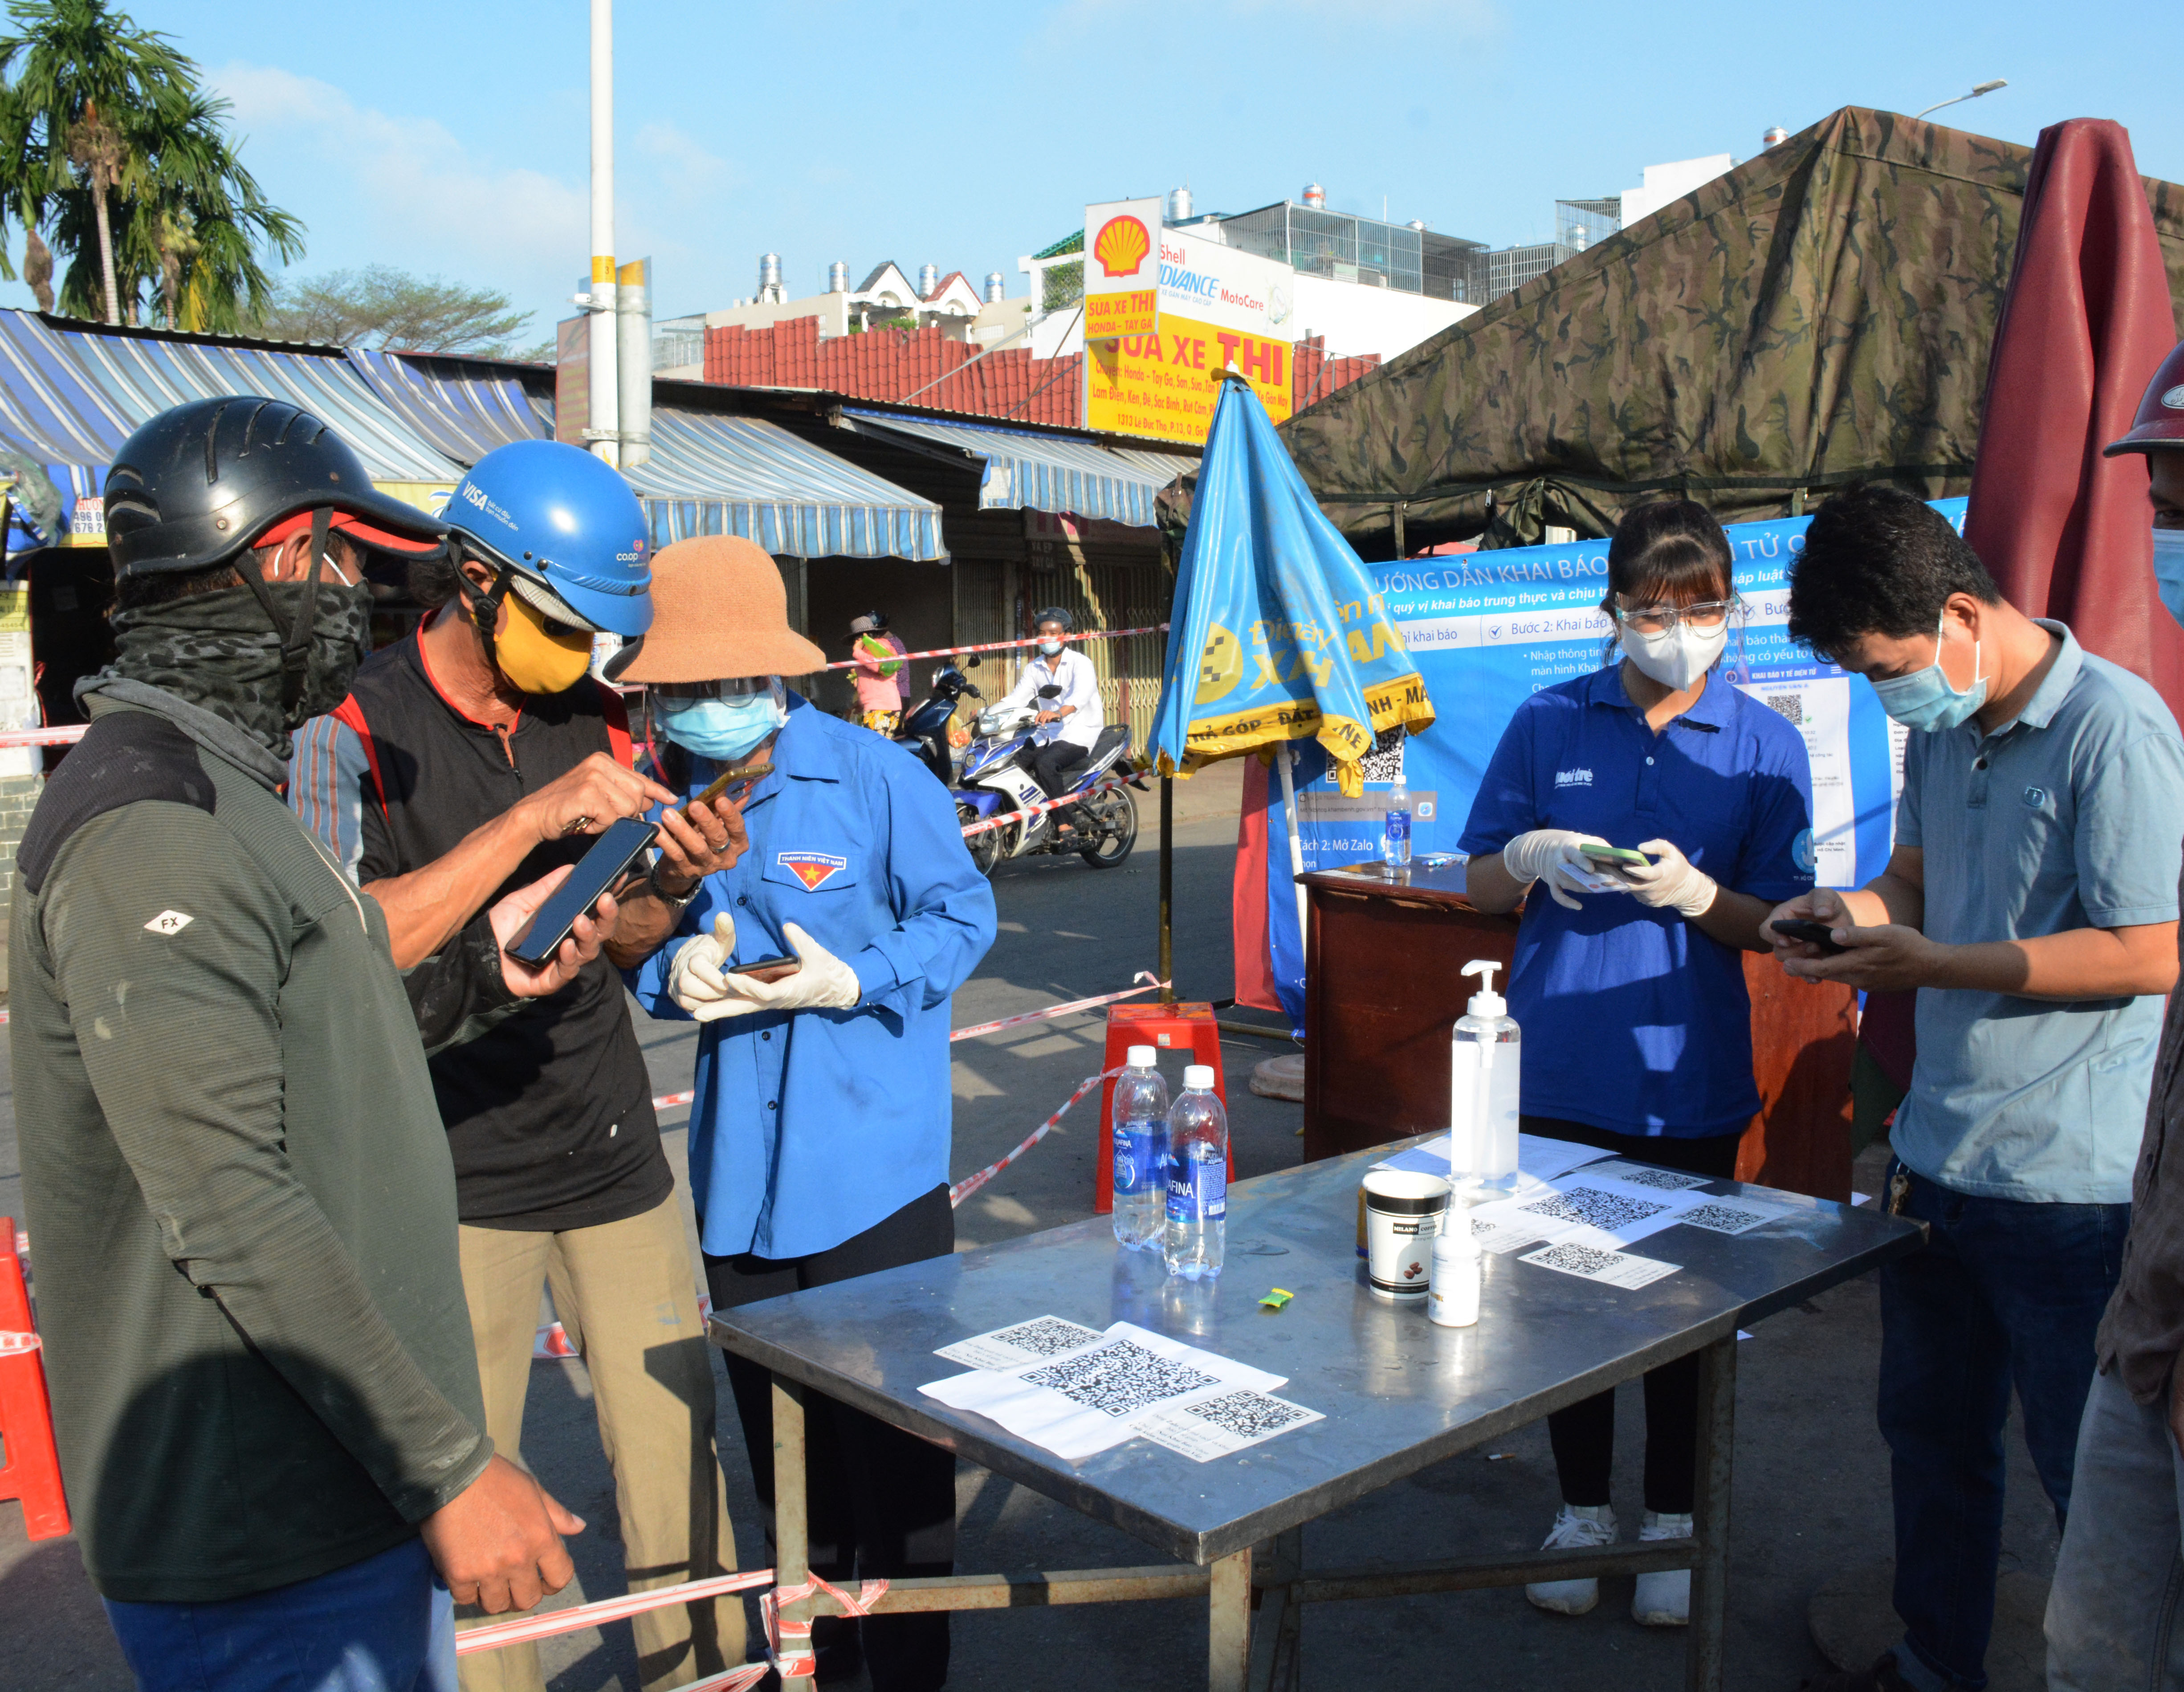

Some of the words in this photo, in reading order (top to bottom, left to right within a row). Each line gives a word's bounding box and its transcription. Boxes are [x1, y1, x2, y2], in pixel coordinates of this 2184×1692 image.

[1161, 244, 1185, 265] Shell
[1160, 264, 1219, 297] DVANCE
[1089, 297, 1111, 317] SỬA
[1114, 300, 1127, 314] XE
[1131, 292, 1154, 313] THI
[1221, 289, 1263, 311] MotoCare
[1125, 319, 1138, 331] TAY
[1141, 318, 1152, 329] GA
[1172, 335, 1206, 370] XE
[1217, 332, 1283, 386] THI
[1125, 364, 1144, 381] Honda
[1152, 370, 1163, 388] Tay
[1118, 414, 1133, 427] 1313
[463, 480, 488, 510] VISA
[1375, 571, 1439, 594] ƯỚNG
[1443, 563, 1493, 588] DẪN
[1497, 561, 1552, 582] KHAI
[1558, 554, 1609, 578] BÁO
[1741, 532, 1779, 559] TỬ
[1394, 601, 1414, 615] quý
[1418, 601, 1428, 613] vị
[1431, 598, 1455, 610] khai
[1459, 597, 1481, 608] báo
[1484, 595, 1516, 607] trung
[1519, 591, 1548, 606] thực
[1551, 589, 1565, 600] và
[1569, 587, 1595, 601] chịu
[1758, 569, 1784, 584] luật
[1413, 630, 1435, 643] khai
[1438, 628, 1457, 641] báo
[1512, 622, 1540, 634] Bước
[1543, 621, 1553, 632] 2:
[1557, 618, 1581, 631] Khai
[1585, 617, 1607, 629] báo
[1530, 651, 1556, 662] Nhập
[1558, 649, 1586, 660] thông
[1589, 647, 1601, 656] tin
[1746, 635, 1767, 646] báo
[1531, 665, 1552, 676] màn
[1554, 663, 1576, 674] hình
[1578, 662, 1598, 672] Khai
[1758, 650, 1771, 661] có
[1774, 648, 1793, 663] yếu
[1786, 669, 1793, 677] TẾ
[1794, 668, 1808, 677] ĐIỆN
[1809, 667, 1817, 675] TỬ
[1222, 719, 1262, 736] GÓP
[1322, 840, 1330, 851] 2:
[1332, 839, 1349, 851] Mở
[1352, 839, 1373, 851] Zalo
[161, 917, 178, 929] FX
[1168, 1179, 1194, 1199] AFINA
